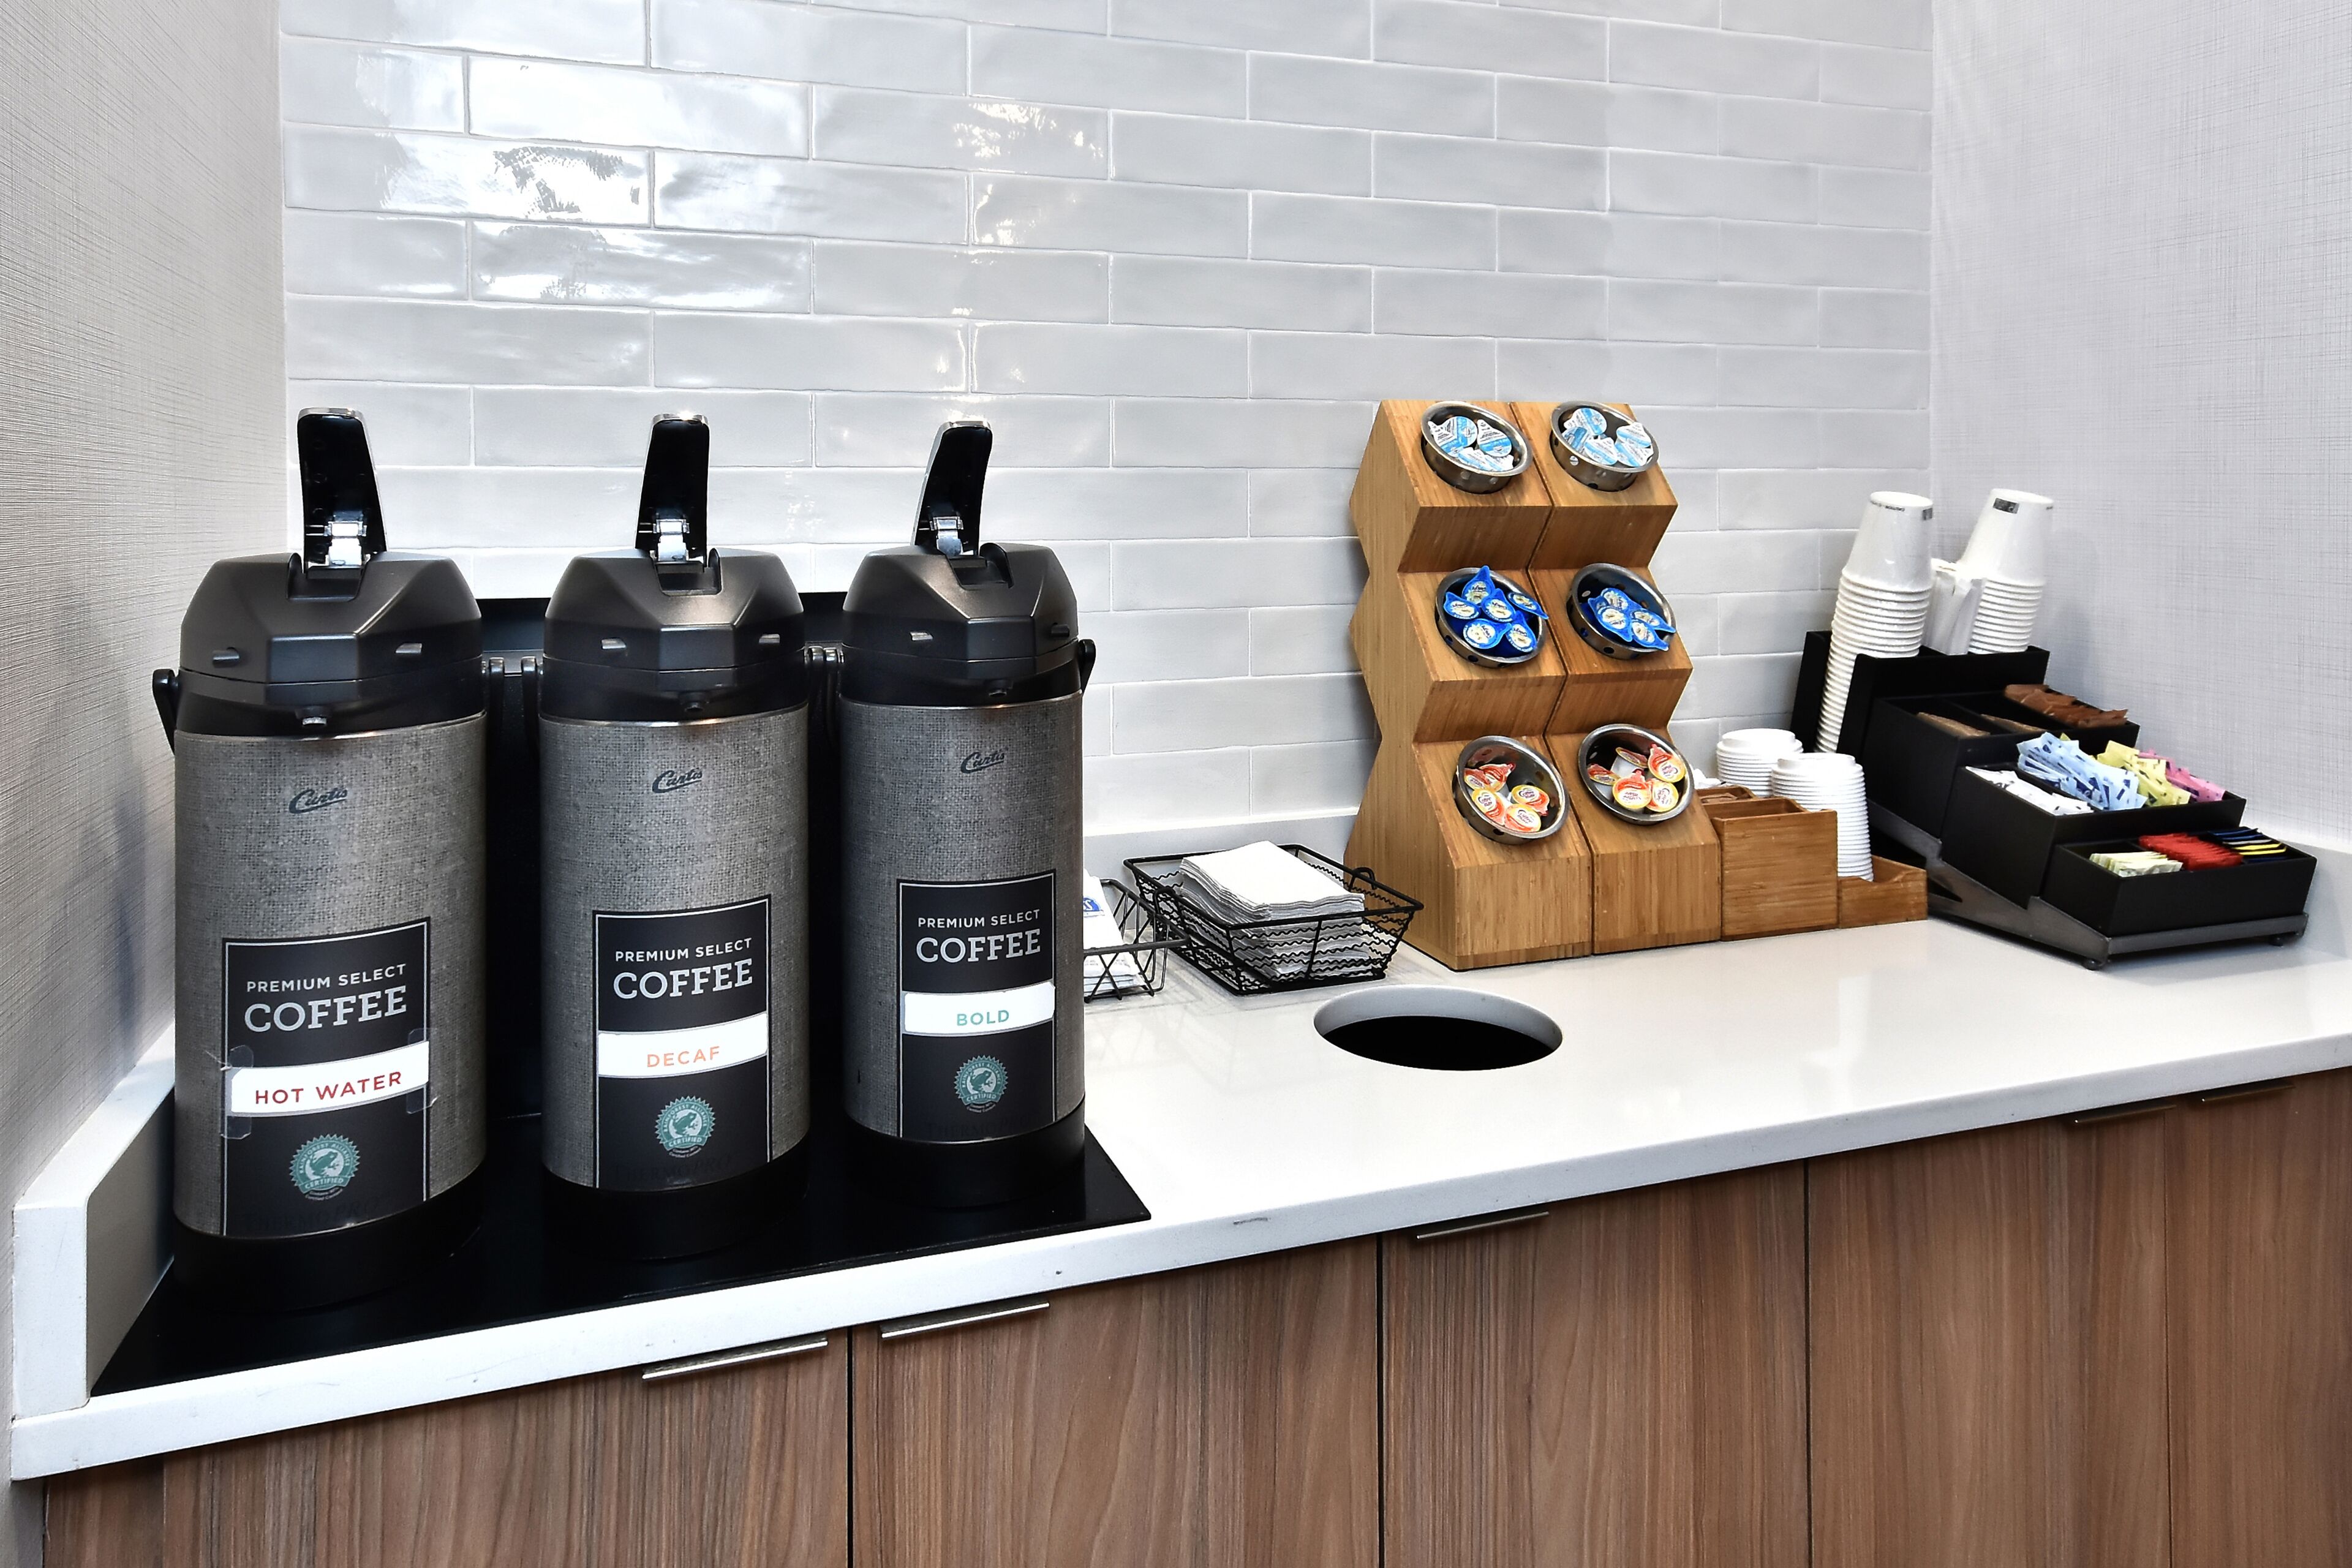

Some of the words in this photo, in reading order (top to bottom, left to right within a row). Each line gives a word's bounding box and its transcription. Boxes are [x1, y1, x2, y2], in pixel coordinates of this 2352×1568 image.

[918, 917, 985, 929] PREMIUM
[990, 909, 1040, 925] SELECT
[615, 948, 689, 962] PREMIUM
[695, 938, 752, 957] SELECT
[916, 929, 1041, 963] COFFEE
[247, 976, 331, 993] PREMIUM
[338, 963, 406, 986] SELECT
[613, 958, 753, 999] COFFEE
[244, 985, 407, 1032] COFFEE
[957, 1010, 1009, 1026] BOLD
[647, 1046, 720, 1068] DECAF
[255, 1088, 304, 1104] HOT
[315, 1071, 402, 1100] WATER
[669, 1136, 702, 1147] CERTIFIED
[305, 1178, 344, 1189] CERTIFIED
